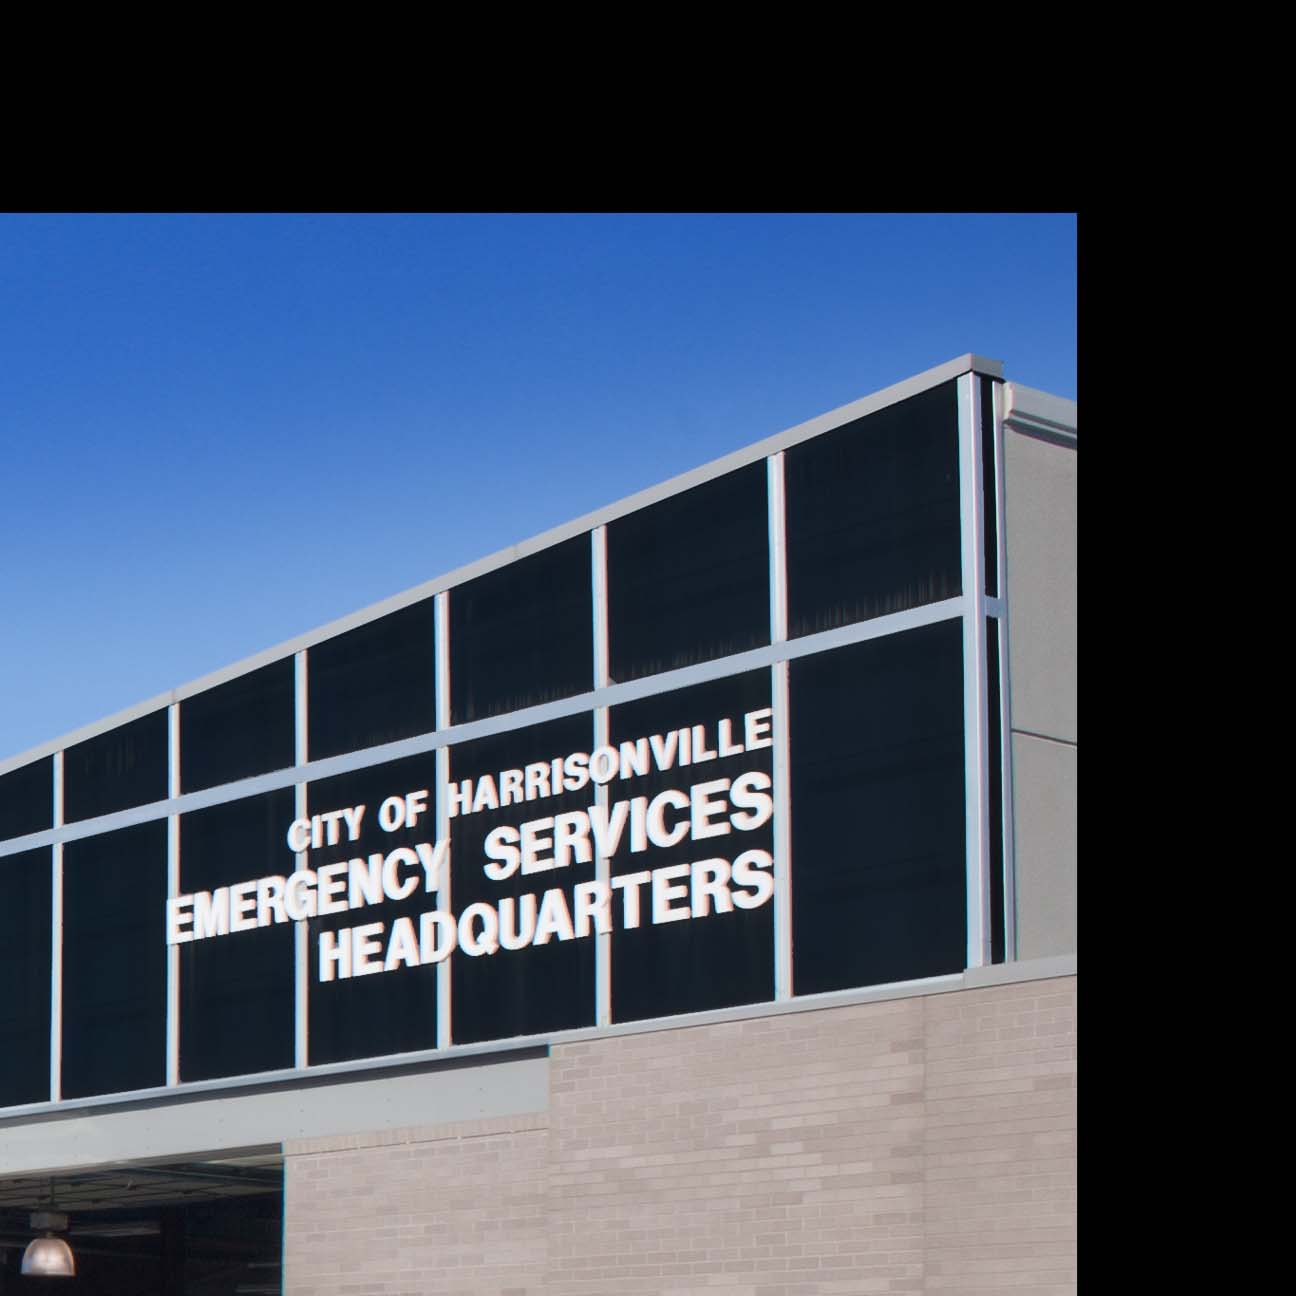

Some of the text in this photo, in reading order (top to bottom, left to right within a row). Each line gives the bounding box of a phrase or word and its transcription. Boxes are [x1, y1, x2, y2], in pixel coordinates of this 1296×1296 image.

[287, 707, 773, 853] CITY OF HARRISONVILLE
[166, 771, 774, 945] EMERGENCY SERVICES
[319, 849, 775, 982] HEADQUARTERS
